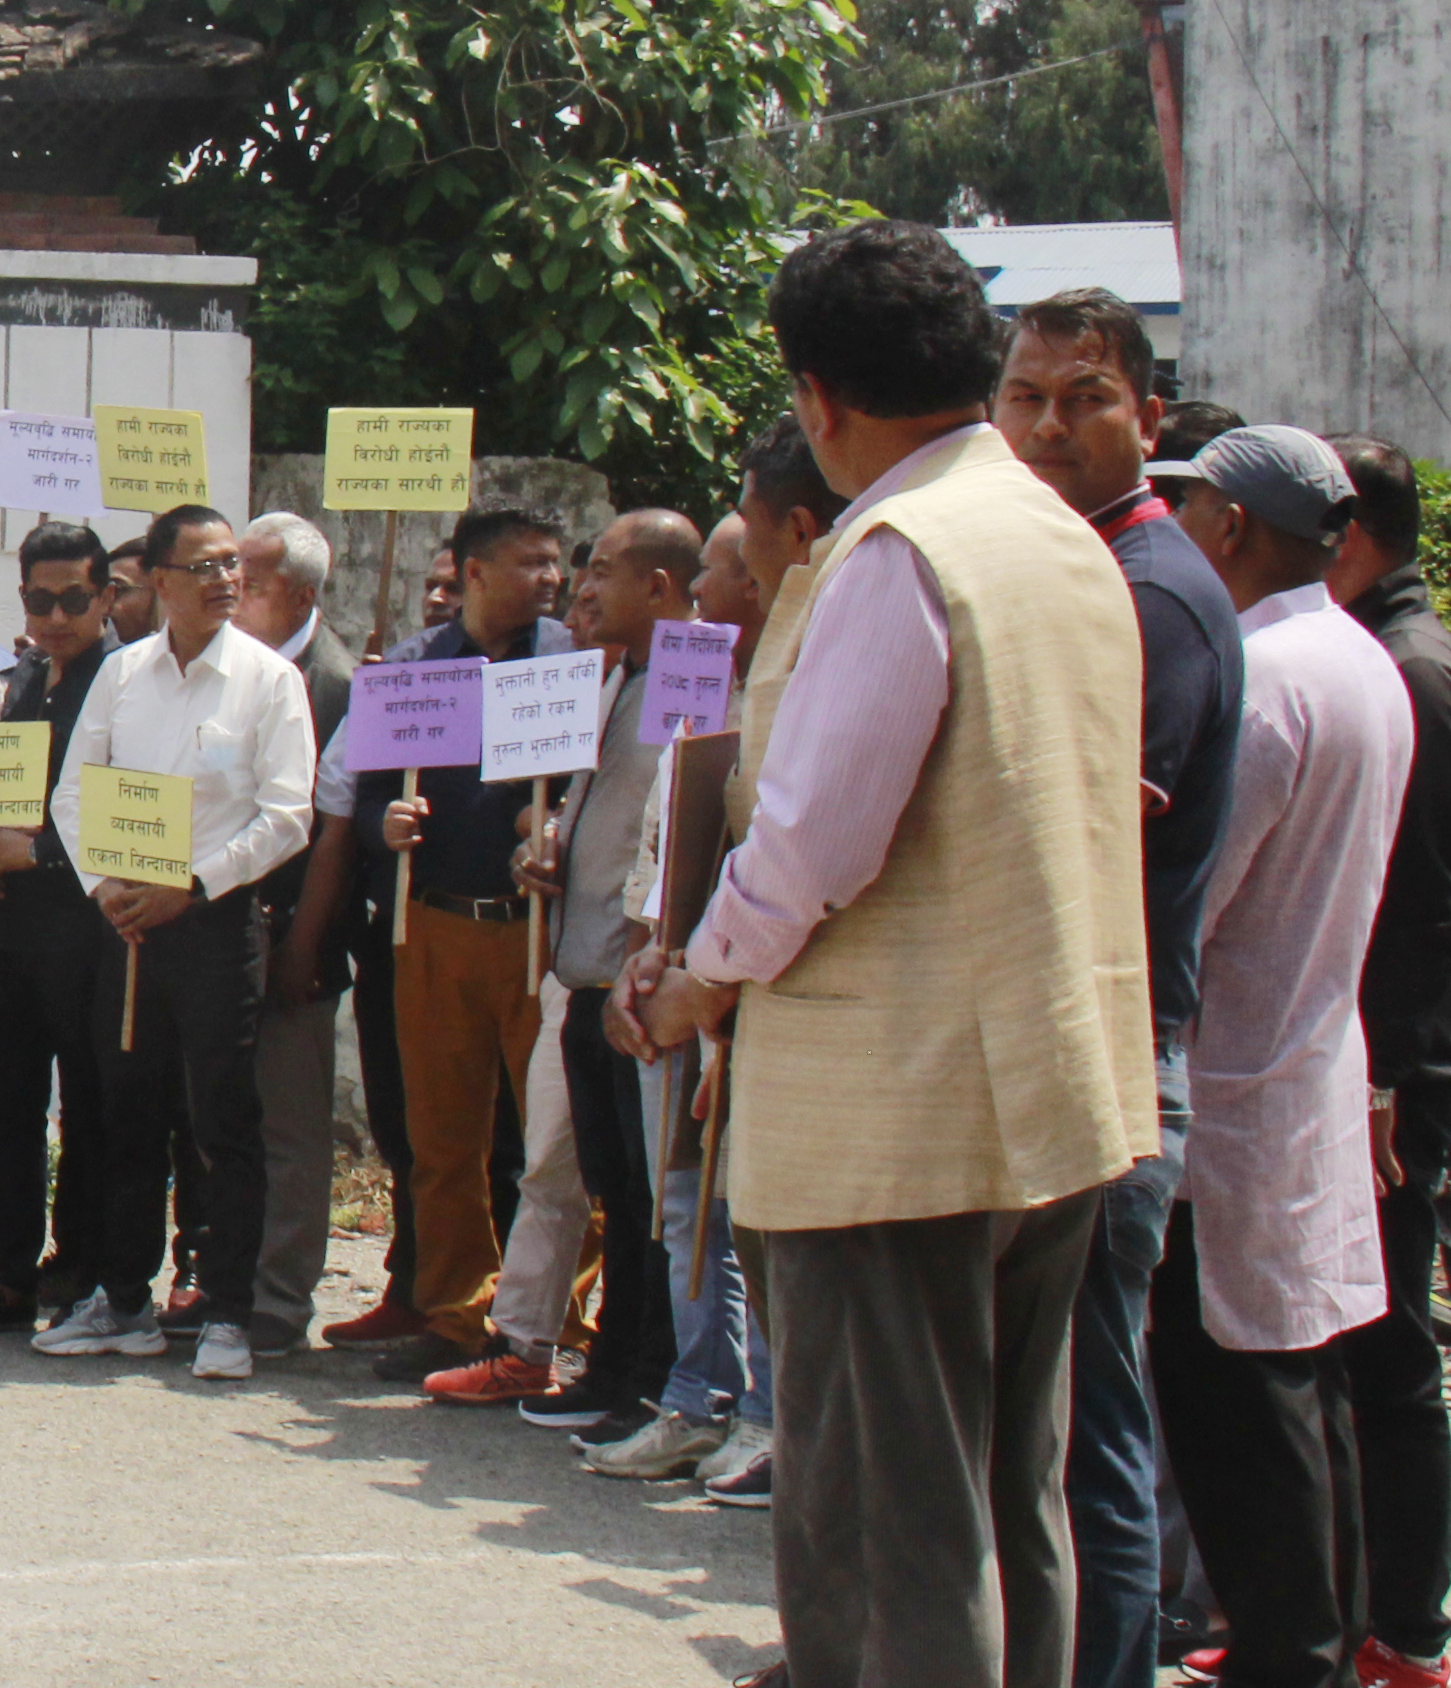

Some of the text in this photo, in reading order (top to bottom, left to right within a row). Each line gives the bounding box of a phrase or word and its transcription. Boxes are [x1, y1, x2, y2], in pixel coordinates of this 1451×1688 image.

[9, 421, 55, 439] मूल्यवृद्धि
[117, 417, 188, 437] हामी राज्यका
[357, 416, 451, 433] हामी राज्यका
[27, 446, 92, 465] मार्गदर्शन-२
[32, 474, 80, 490] जारी गर
[109, 476, 148, 492] राज्यका
[155, 478, 189, 495] सारथी
[336, 478, 389, 491] राज्यका
[398, 474, 442, 491] सारथी
[496, 667, 535, 696] भुक्तानी
[543, 669, 560, 690] हुन
[385, 695, 457, 713] मार्गदर्शन-२
[512, 699, 576, 721] रहेको रकम
[392, 724, 445, 741] जारी गर
[492, 730, 594, 764] तुरुन्त भुक्तानी गर
[119, 778, 159, 801] निर्माण
[111, 814, 165, 839] व्यवसायी
[87, 847, 123, 867] एकता
